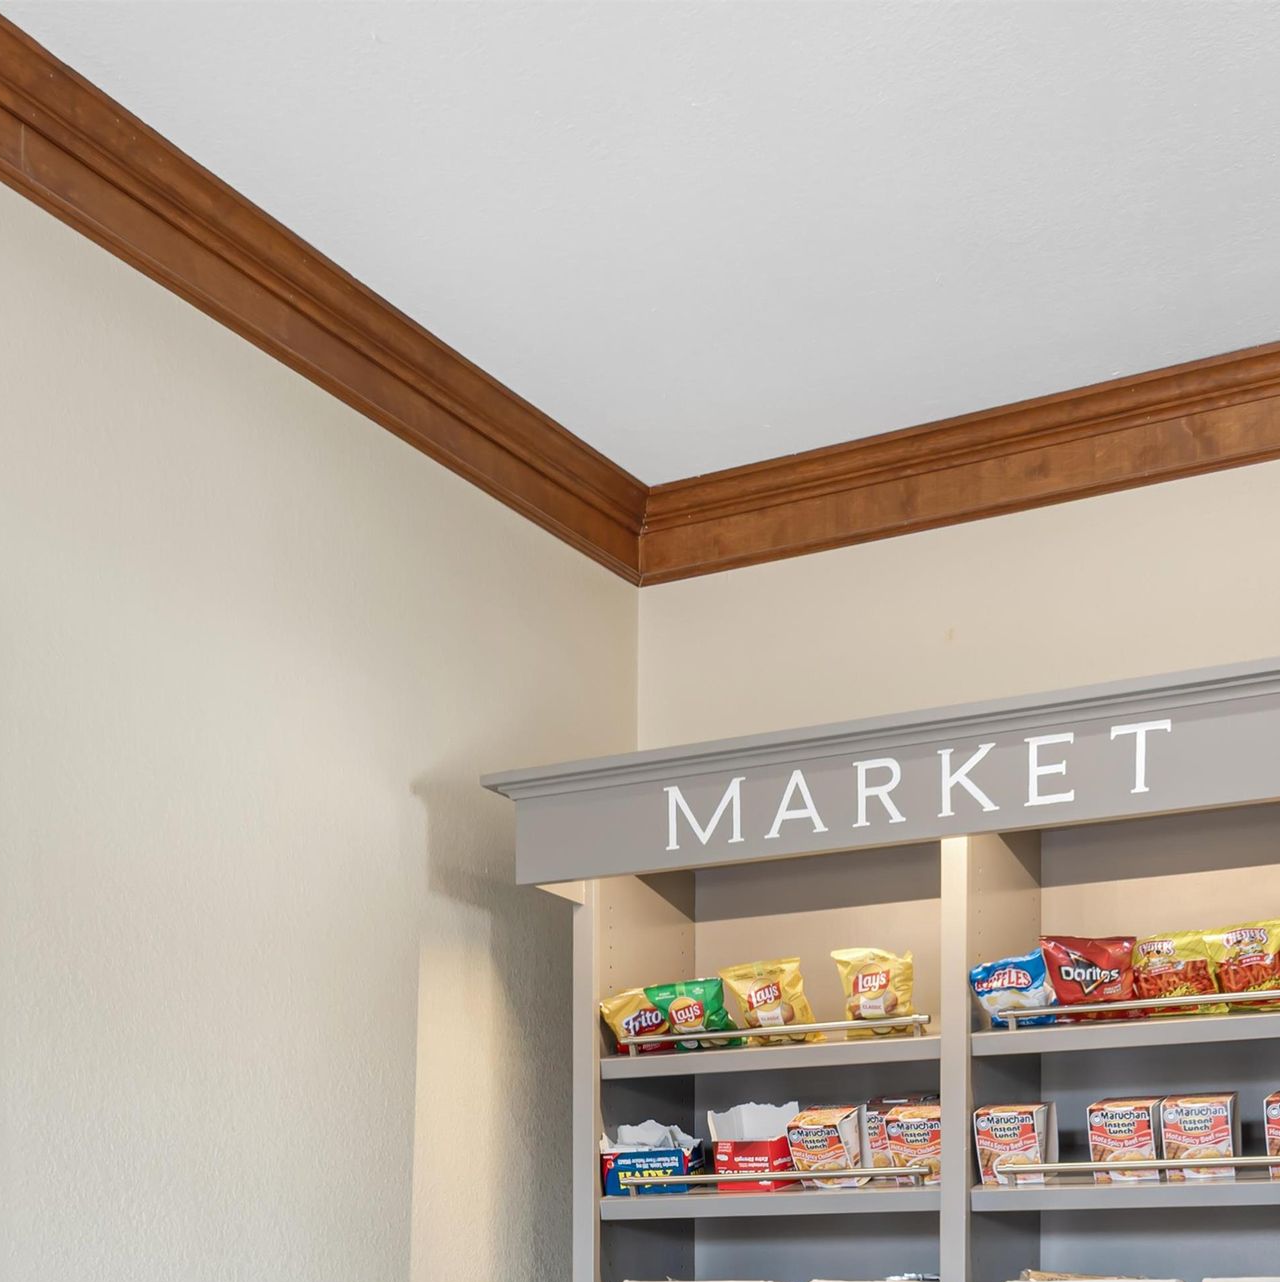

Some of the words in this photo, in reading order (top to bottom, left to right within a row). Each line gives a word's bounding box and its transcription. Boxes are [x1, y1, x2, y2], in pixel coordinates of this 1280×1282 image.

[663, 718, 1172, 851] MARKET
[1060, 965, 1120, 983] Doritos
[857, 970, 888, 993] Lay's
[750, 983, 780, 1008] Lay's
[671, 1003, 701, 1024] Lay's
[623, 1009, 665, 1036] Frito
[1101, 1111, 1147, 1120] Maruchan
[1175, 1107, 1225, 1117] Maruchan
[897, 1122, 940, 1131] Maruchan
[987, 1115, 1031, 1124] Maruchan
[1104, 1121, 1136, 1129] Instant
[797, 1129, 836, 1137] Maruchan
